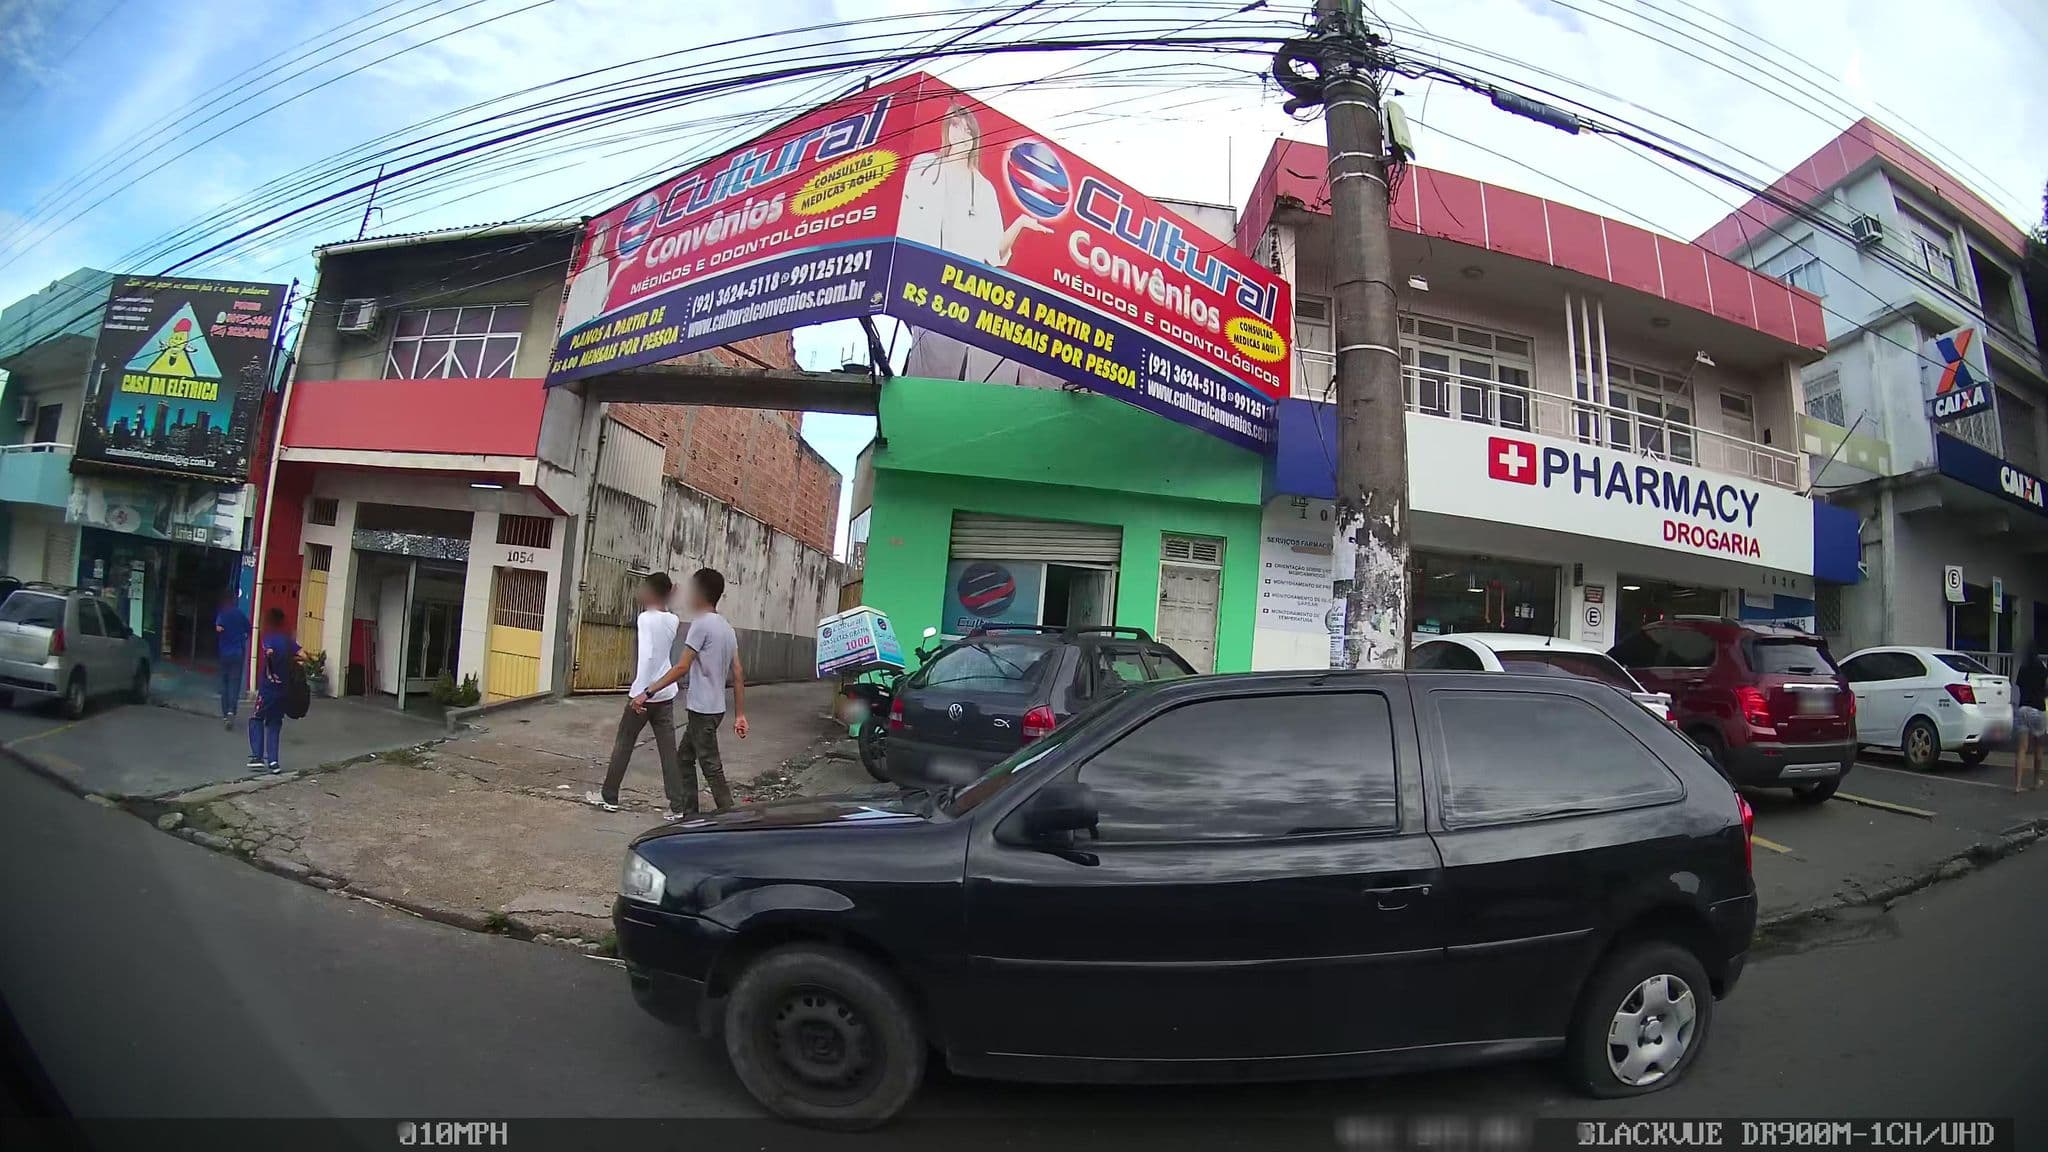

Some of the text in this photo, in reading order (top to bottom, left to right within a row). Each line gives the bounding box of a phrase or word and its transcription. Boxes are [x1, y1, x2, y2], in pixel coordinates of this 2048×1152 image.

[657, 96, 892, 228] Cultural
[814, 155, 874, 188] CONSULTAS
[801, 182, 846, 210] MEDICAS
[630, 206, 877, 294] MÉDICOS E ODONTOLÓGICOS
[645, 192, 786, 268] Convênios
[1074, 176, 1278, 324] Cultural
[691, 249, 873, 319] (92) 3624-5118 991251291
[1068, 230, 1220, 333] Convênios
[569, 305, 667, 350] PLANOS A PARTIR DE
[687, 278, 866, 339] www.culturalconvenios.com.br
[940, 264, 1115, 353] PLANOS A PARTIR DE
[1053, 268, 1280, 388] MÉDICOS E ODONTOLÓGICOS
[1239, 322, 1273, 340] CONSULTAS
[578, 341, 618, 367] MENSAIS
[617, 336, 641, 358] POR
[640, 325, 680, 352] PESSOA
[902, 282, 1136, 390] R$ 8,00 MENSAIS POR PESSOA
[1233, 334, 1260, 350] MEDICAS
[121, 374, 218, 401] CASA DA ELÉTRICA
[1148, 352, 1171, 383] (92)
[1173, 365, 1227, 403] 3624-5118
[1935, 386, 1985, 418] CAIXA
[1543, 446, 1760, 528] PHARMACY
[2000, 466, 2044, 507] CAIXA
[507, 551, 534, 563] 1054
[1663, 520, 1761, 558] DROGARIA
[1589, 610, 1598, 624] E
[846, 635, 870, 651] 1000
